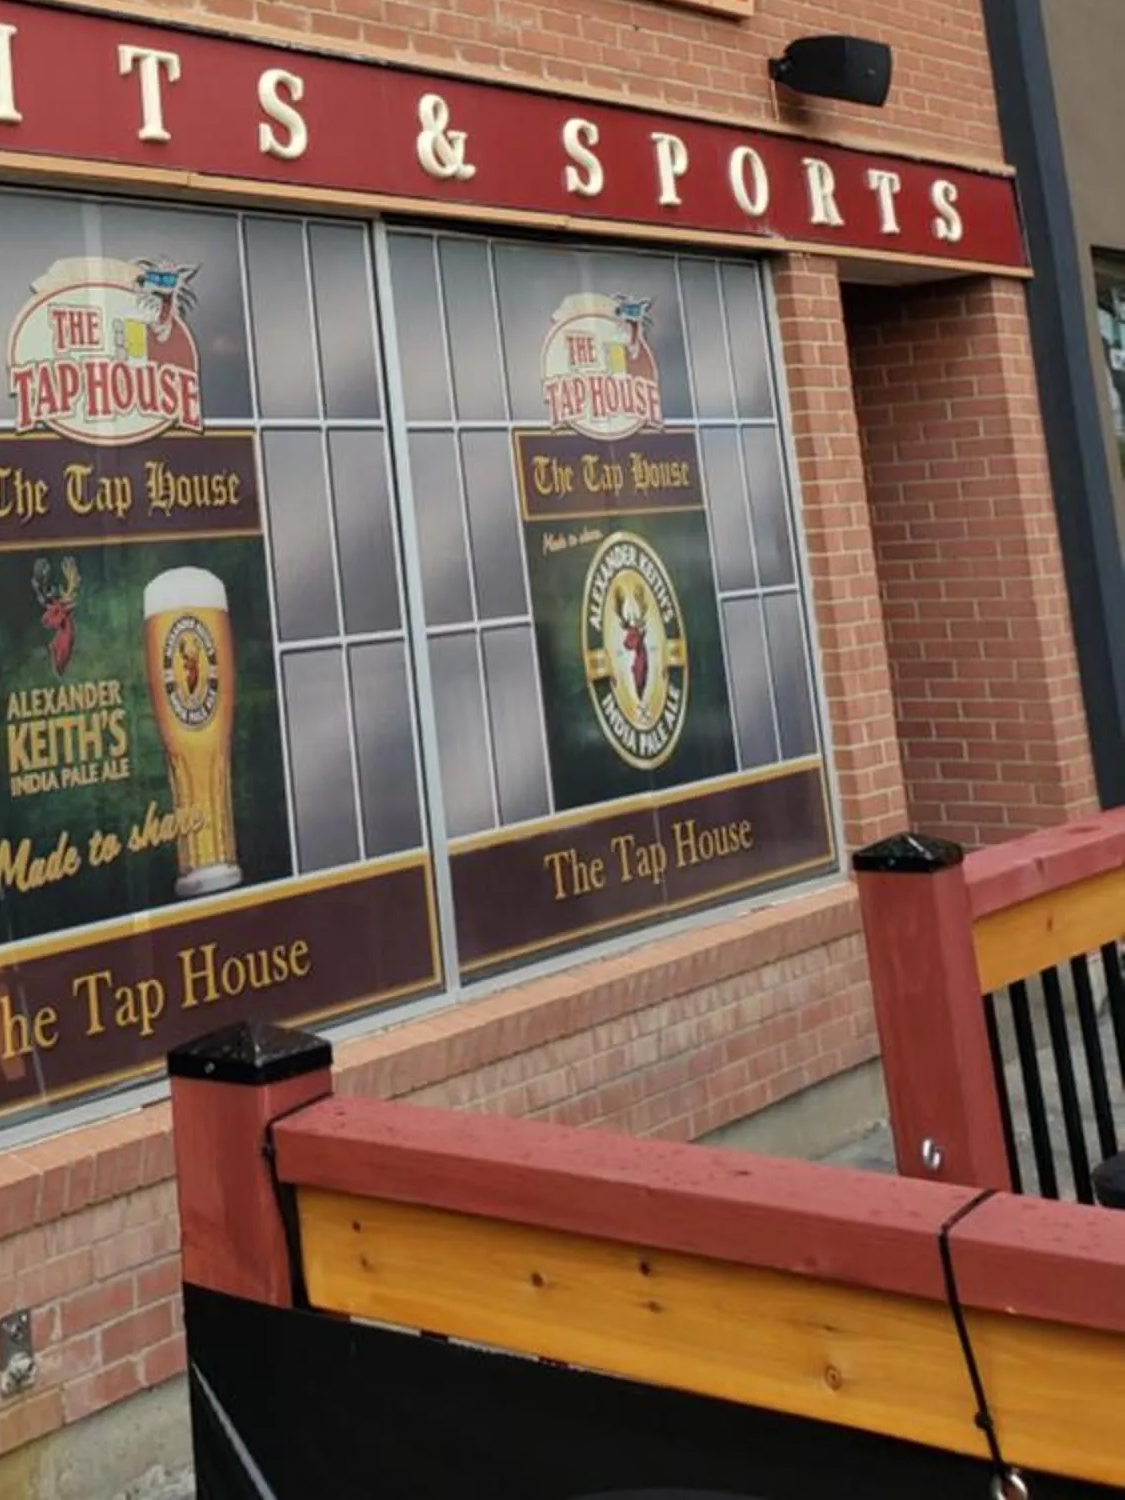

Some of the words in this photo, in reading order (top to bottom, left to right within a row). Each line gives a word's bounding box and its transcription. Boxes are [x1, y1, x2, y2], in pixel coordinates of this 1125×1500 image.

[416, 92, 477, 180] &
[562, 117, 964, 243] SPORTS
[52, 308, 100, 350] THE
[567, 334, 596, 366] THE
[13, 361, 81, 429] TAP
[84, 360, 203, 427] HOUSE
[64, 463, 132, 519] Tap
[145, 460, 242, 517] House
[532, 454, 574, 500] The
[581, 453, 624, 497] Tap
[629, 451, 690, 497] House
[589, 544, 638, 632] ALEXANDER
[639, 550, 674, 623] KEITH'S
[7, 679, 123, 721] ALEXANDER
[601, 692, 638, 754] INDIA
[639, 720, 669, 757] PALE
[663, 683, 681, 732] ALE
[7, 708, 127, 774] KEITH'S
[10, 770, 61, 797] INDIA
[60, 762, 100, 789] PALE
[102, 757, 131, 783] ALE
[87, 829, 122, 867] to
[127, 800, 206, 852] share
[543, 847, 605, 901] The
[611, 832, 667, 885] Tap
[671, 817, 754, 870] House
[73, 970, 166, 1037] Tap
[177, 938, 313, 1007] House
